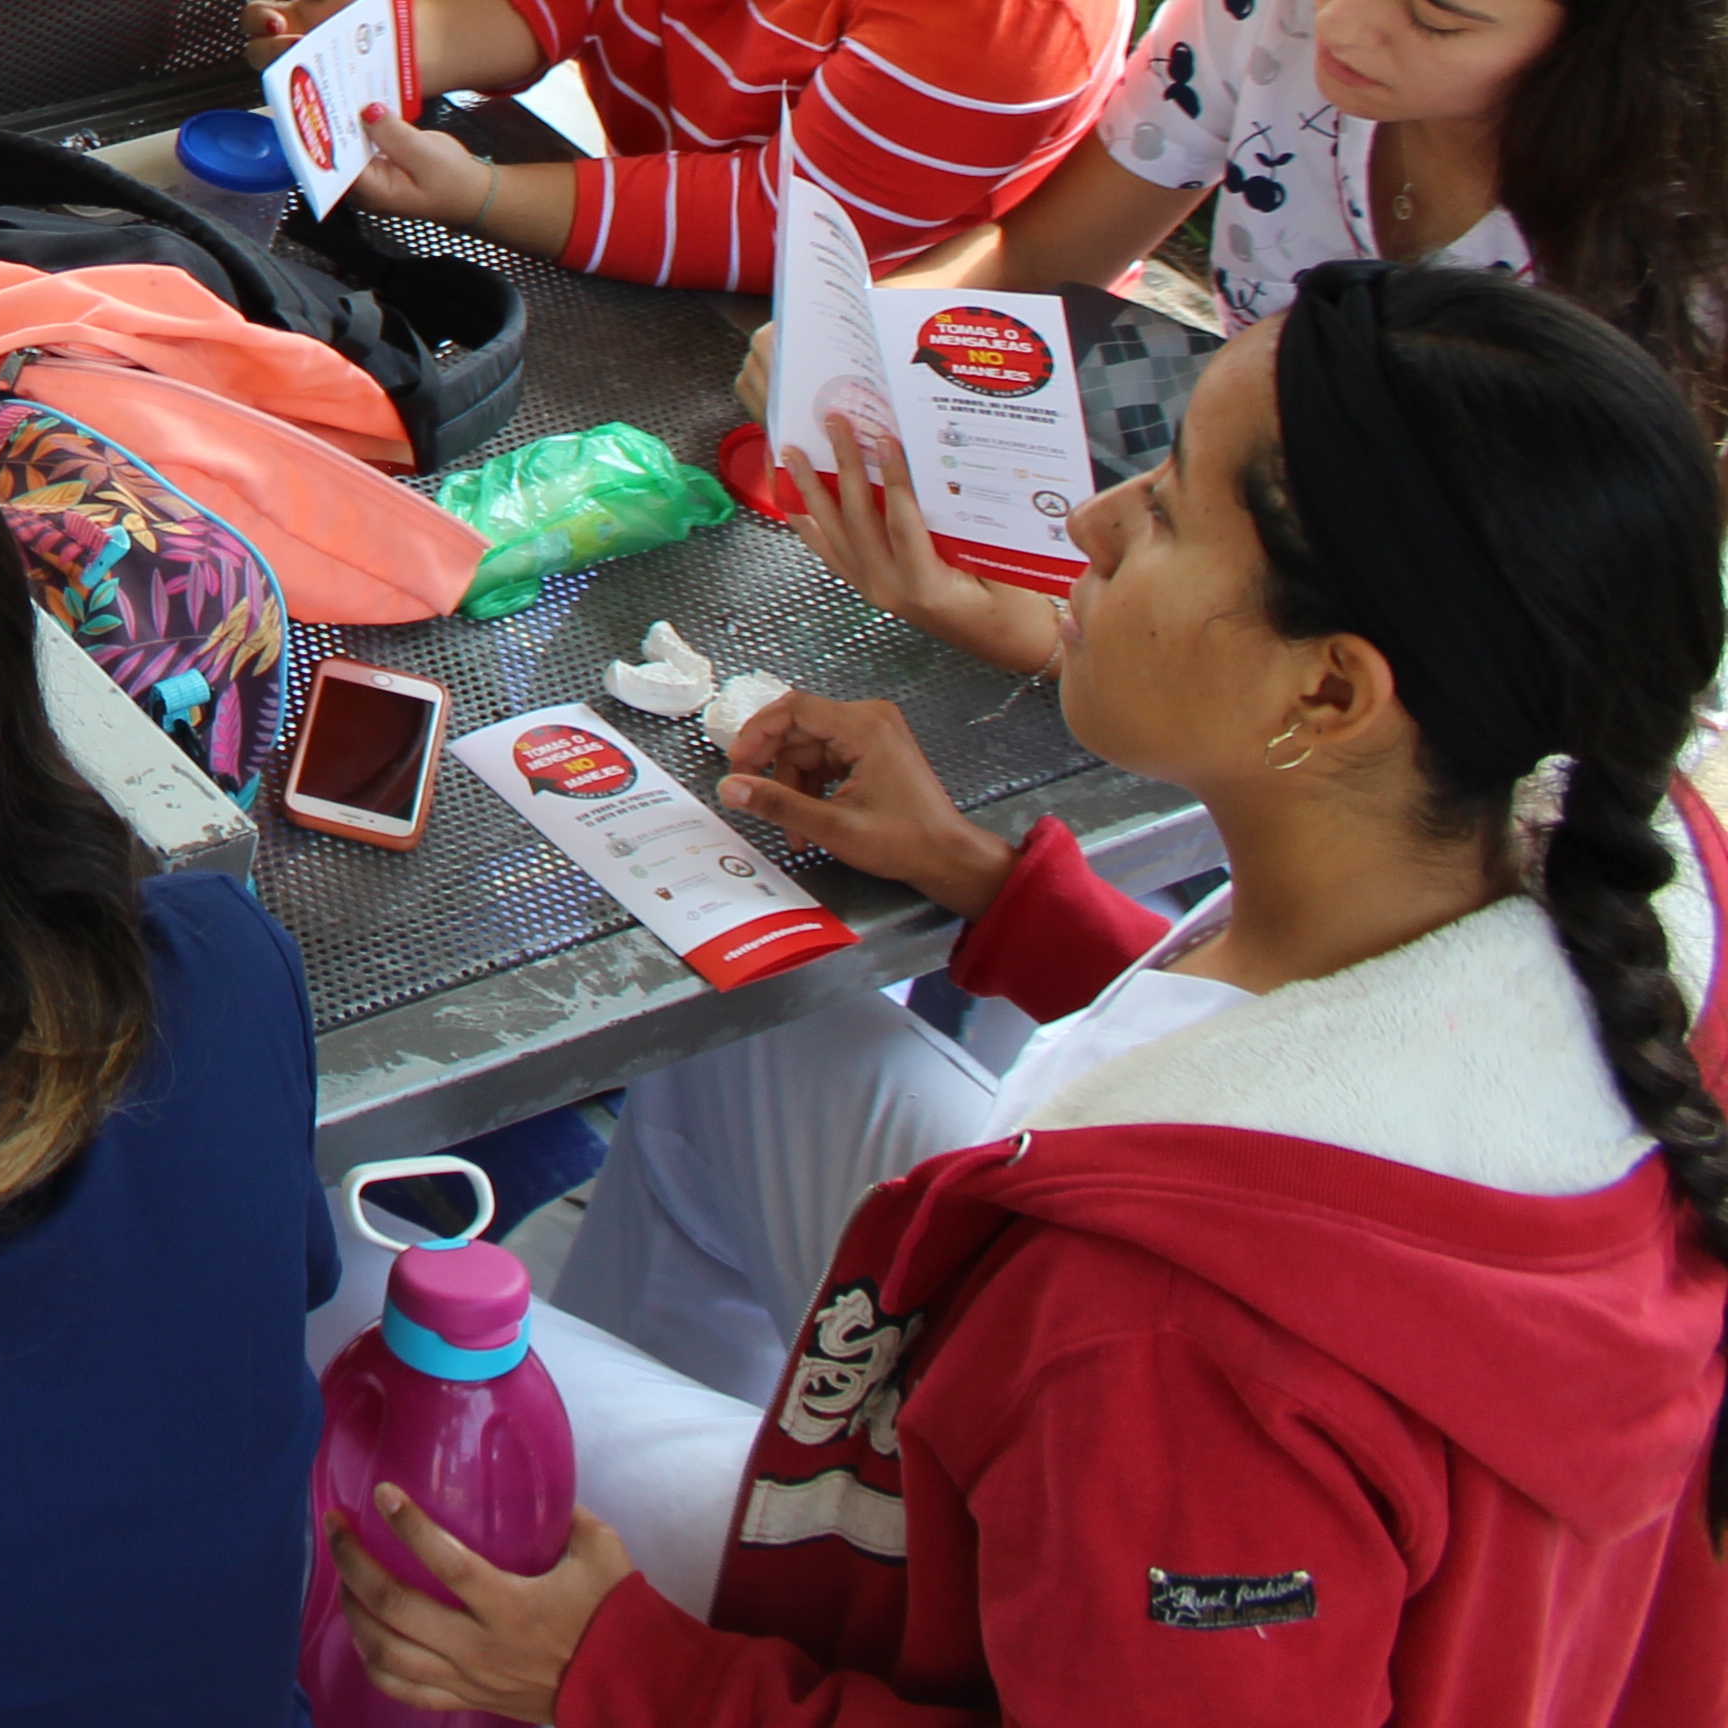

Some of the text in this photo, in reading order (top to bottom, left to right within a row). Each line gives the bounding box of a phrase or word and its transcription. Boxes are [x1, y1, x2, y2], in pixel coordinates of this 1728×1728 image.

[935, 313, 952, 323] SI
[936, 323, 1019, 340] TOMAS O
[929, 334, 1034, 353] MENSAJEAS
[967, 349, 1005, 365] NO
[951, 364, 1031, 382] MANEJES
[521, 732, 586, 760] TOMAS O
[525, 739, 605, 772] MENSAJEAS
[563, 755, 596, 776] NO
[562, 763, 625, 790] MANEJES
[1235, 1580, 1302, 1609] fashion
